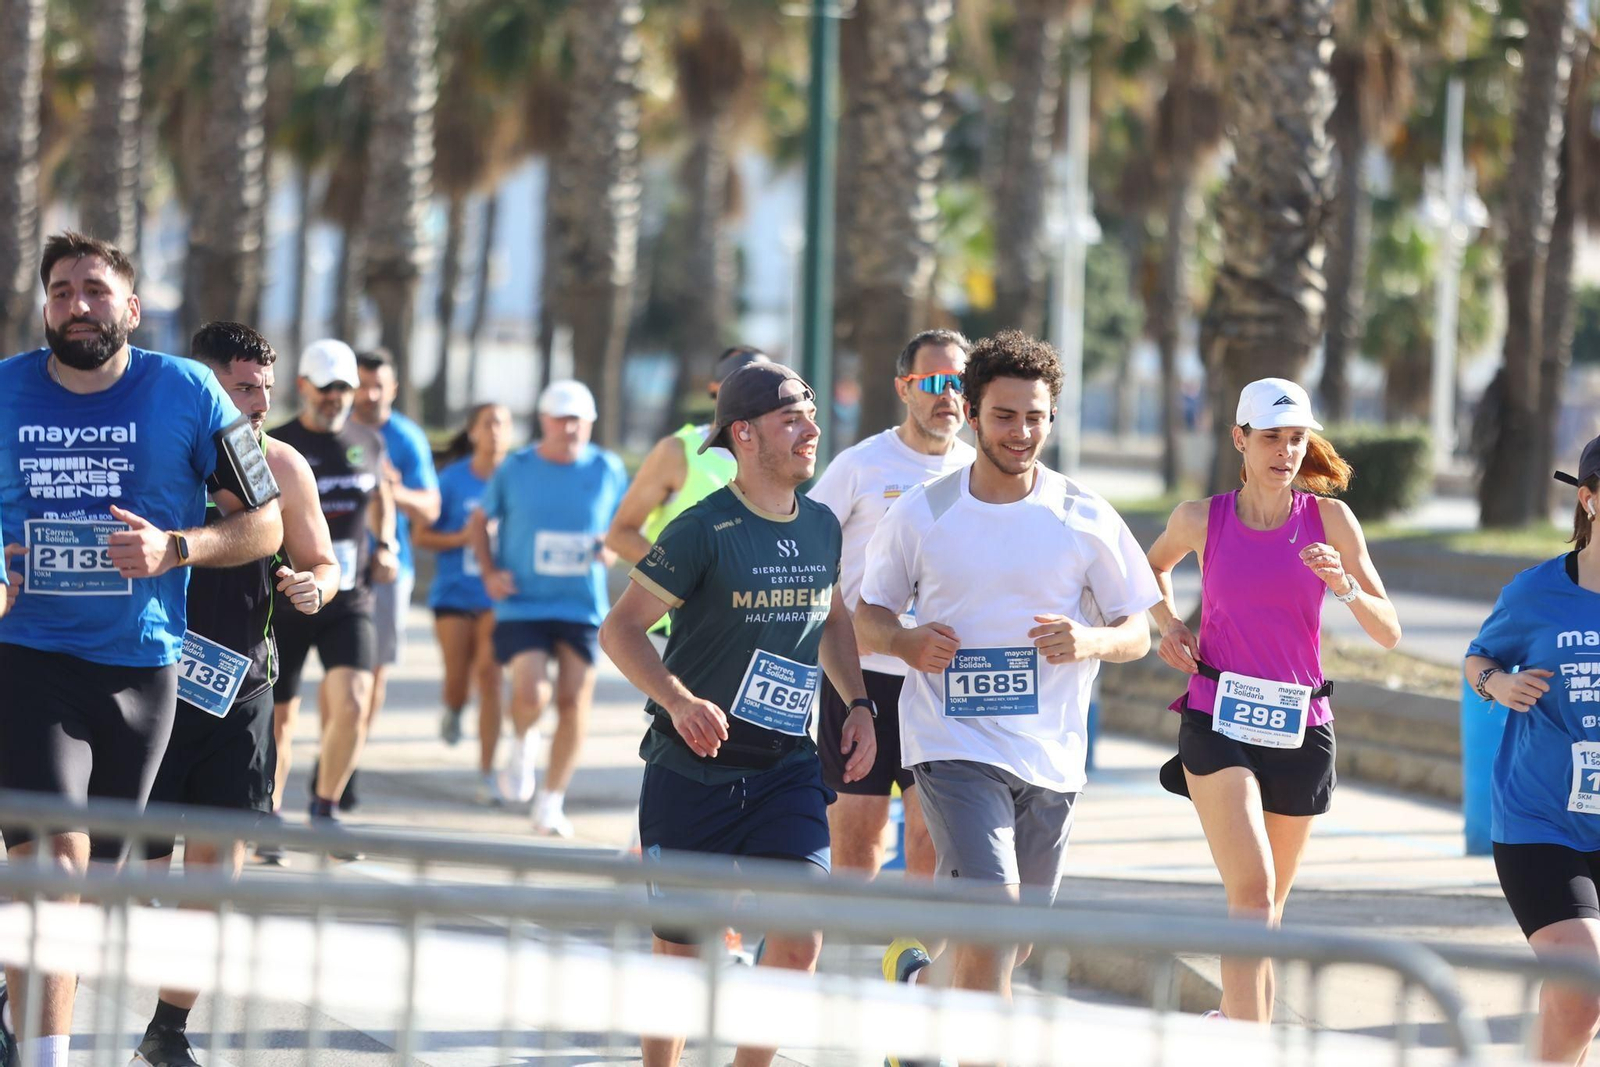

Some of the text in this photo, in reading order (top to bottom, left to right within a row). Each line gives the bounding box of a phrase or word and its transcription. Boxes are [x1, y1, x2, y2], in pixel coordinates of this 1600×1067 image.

[18, 422, 137, 448] mayoral
[19, 457, 129, 472] RUNNING
[29, 472, 120, 484] MAKES
[29, 485, 122, 499] FRIENDS
[45, 528, 74, 537] Carrera
[45, 535, 80, 544] Solidaria
[752, 567, 788, 575] SIERRA
[791, 565, 827, 573] BLANCA
[771, 575, 814, 584] ESTATES
[732, 588, 832, 609] MARBELL
[745, 613, 774, 623] HALF
[185, 640, 203, 651] arrera
[1557, 630, 1600, 649] ma
[182, 645, 205, 659] olidaria
[1004, 649, 1034, 657] mayoral
[220, 652, 245, 666] mayoral
[958, 661, 992, 669] Solidaria
[768, 663, 794, 675] Carrera
[178, 659, 230, 693] 138
[766, 669, 795, 683] Solidaria
[956, 673, 1028, 695] 1685
[1234, 681, 1261, 692] Carrera
[756, 680, 811, 712] 1694
[1233, 688, 1265, 701] Solidaria
[1278, 687, 1306, 696] mayoral
[1234, 704, 1286, 729] 298
